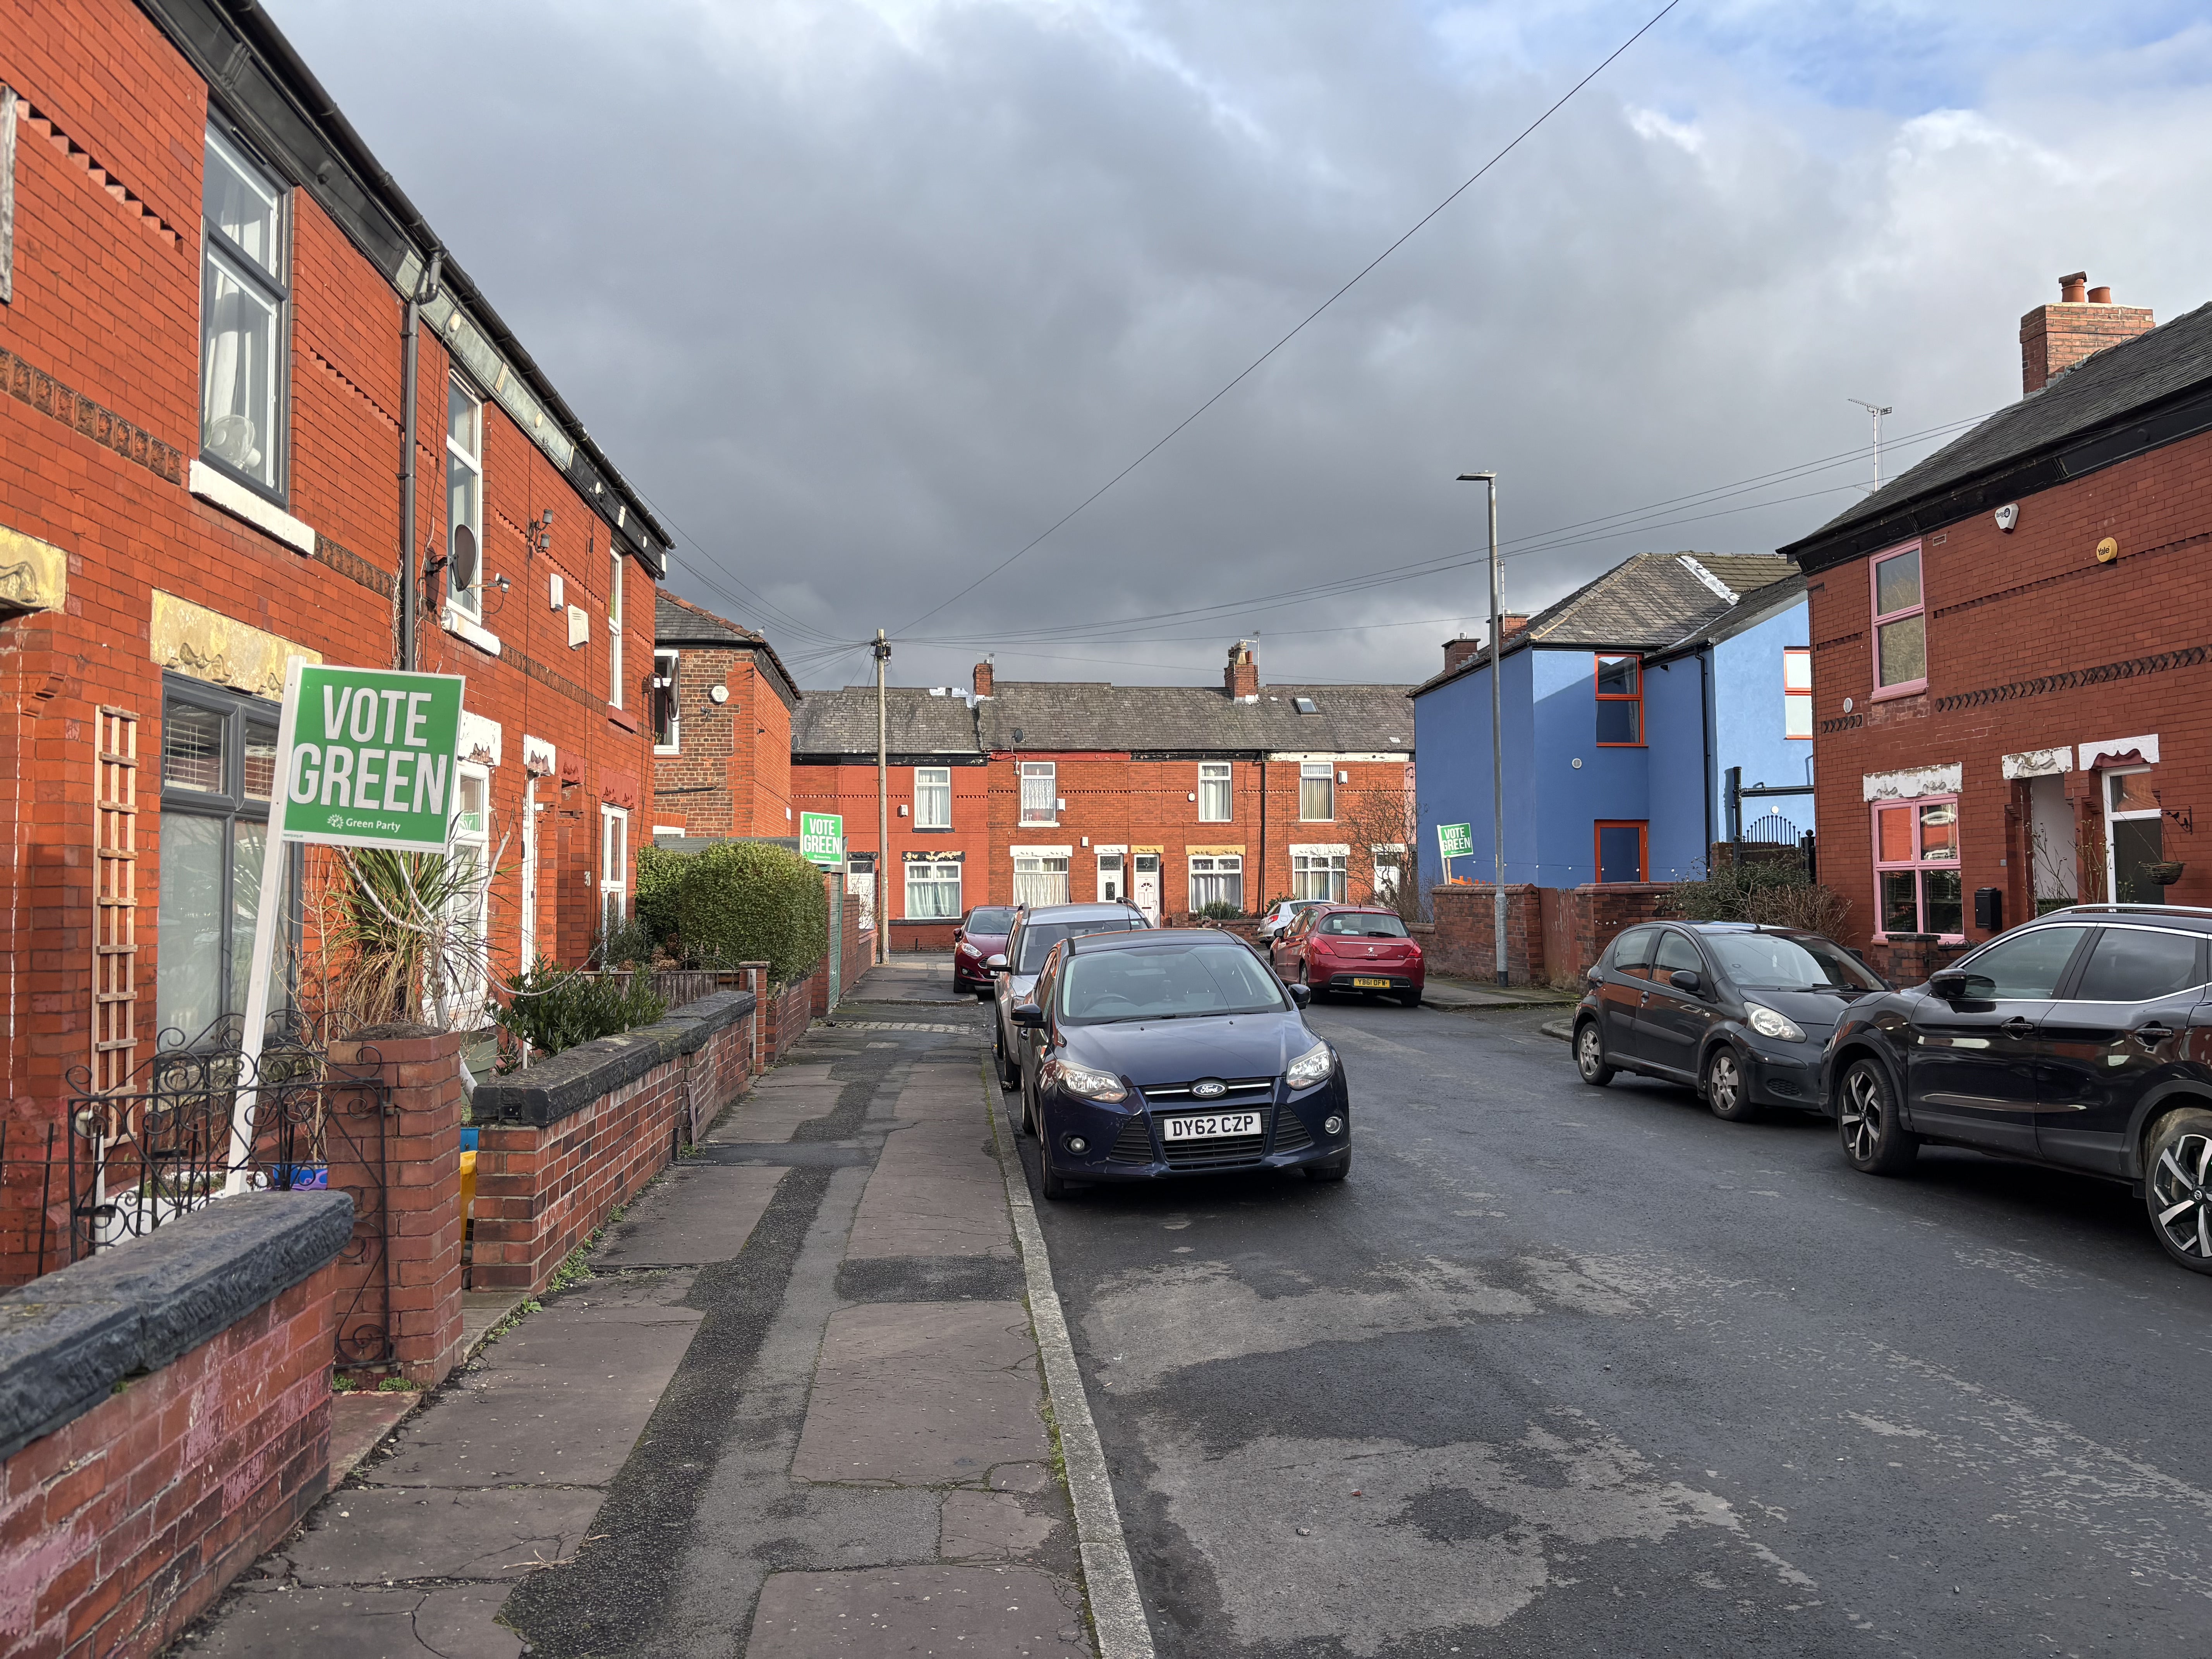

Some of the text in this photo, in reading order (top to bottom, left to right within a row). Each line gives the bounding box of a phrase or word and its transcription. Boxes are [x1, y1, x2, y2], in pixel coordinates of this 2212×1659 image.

[2098, 546, 2110, 556] Yale
[323, 685, 432, 747] VOTE
[289, 743, 447, 815] GREEN
[346, 818, 400, 833] Green Party
[809, 818, 835, 835] VOTE
[1444, 827, 1465, 839] VOTE
[804, 834, 840, 854] GREEN
[1442, 837, 1471, 852] GREEN
[1200, 1085, 1218, 1093] Ford
[1172, 1116, 1253, 1136] DY62 CZP
